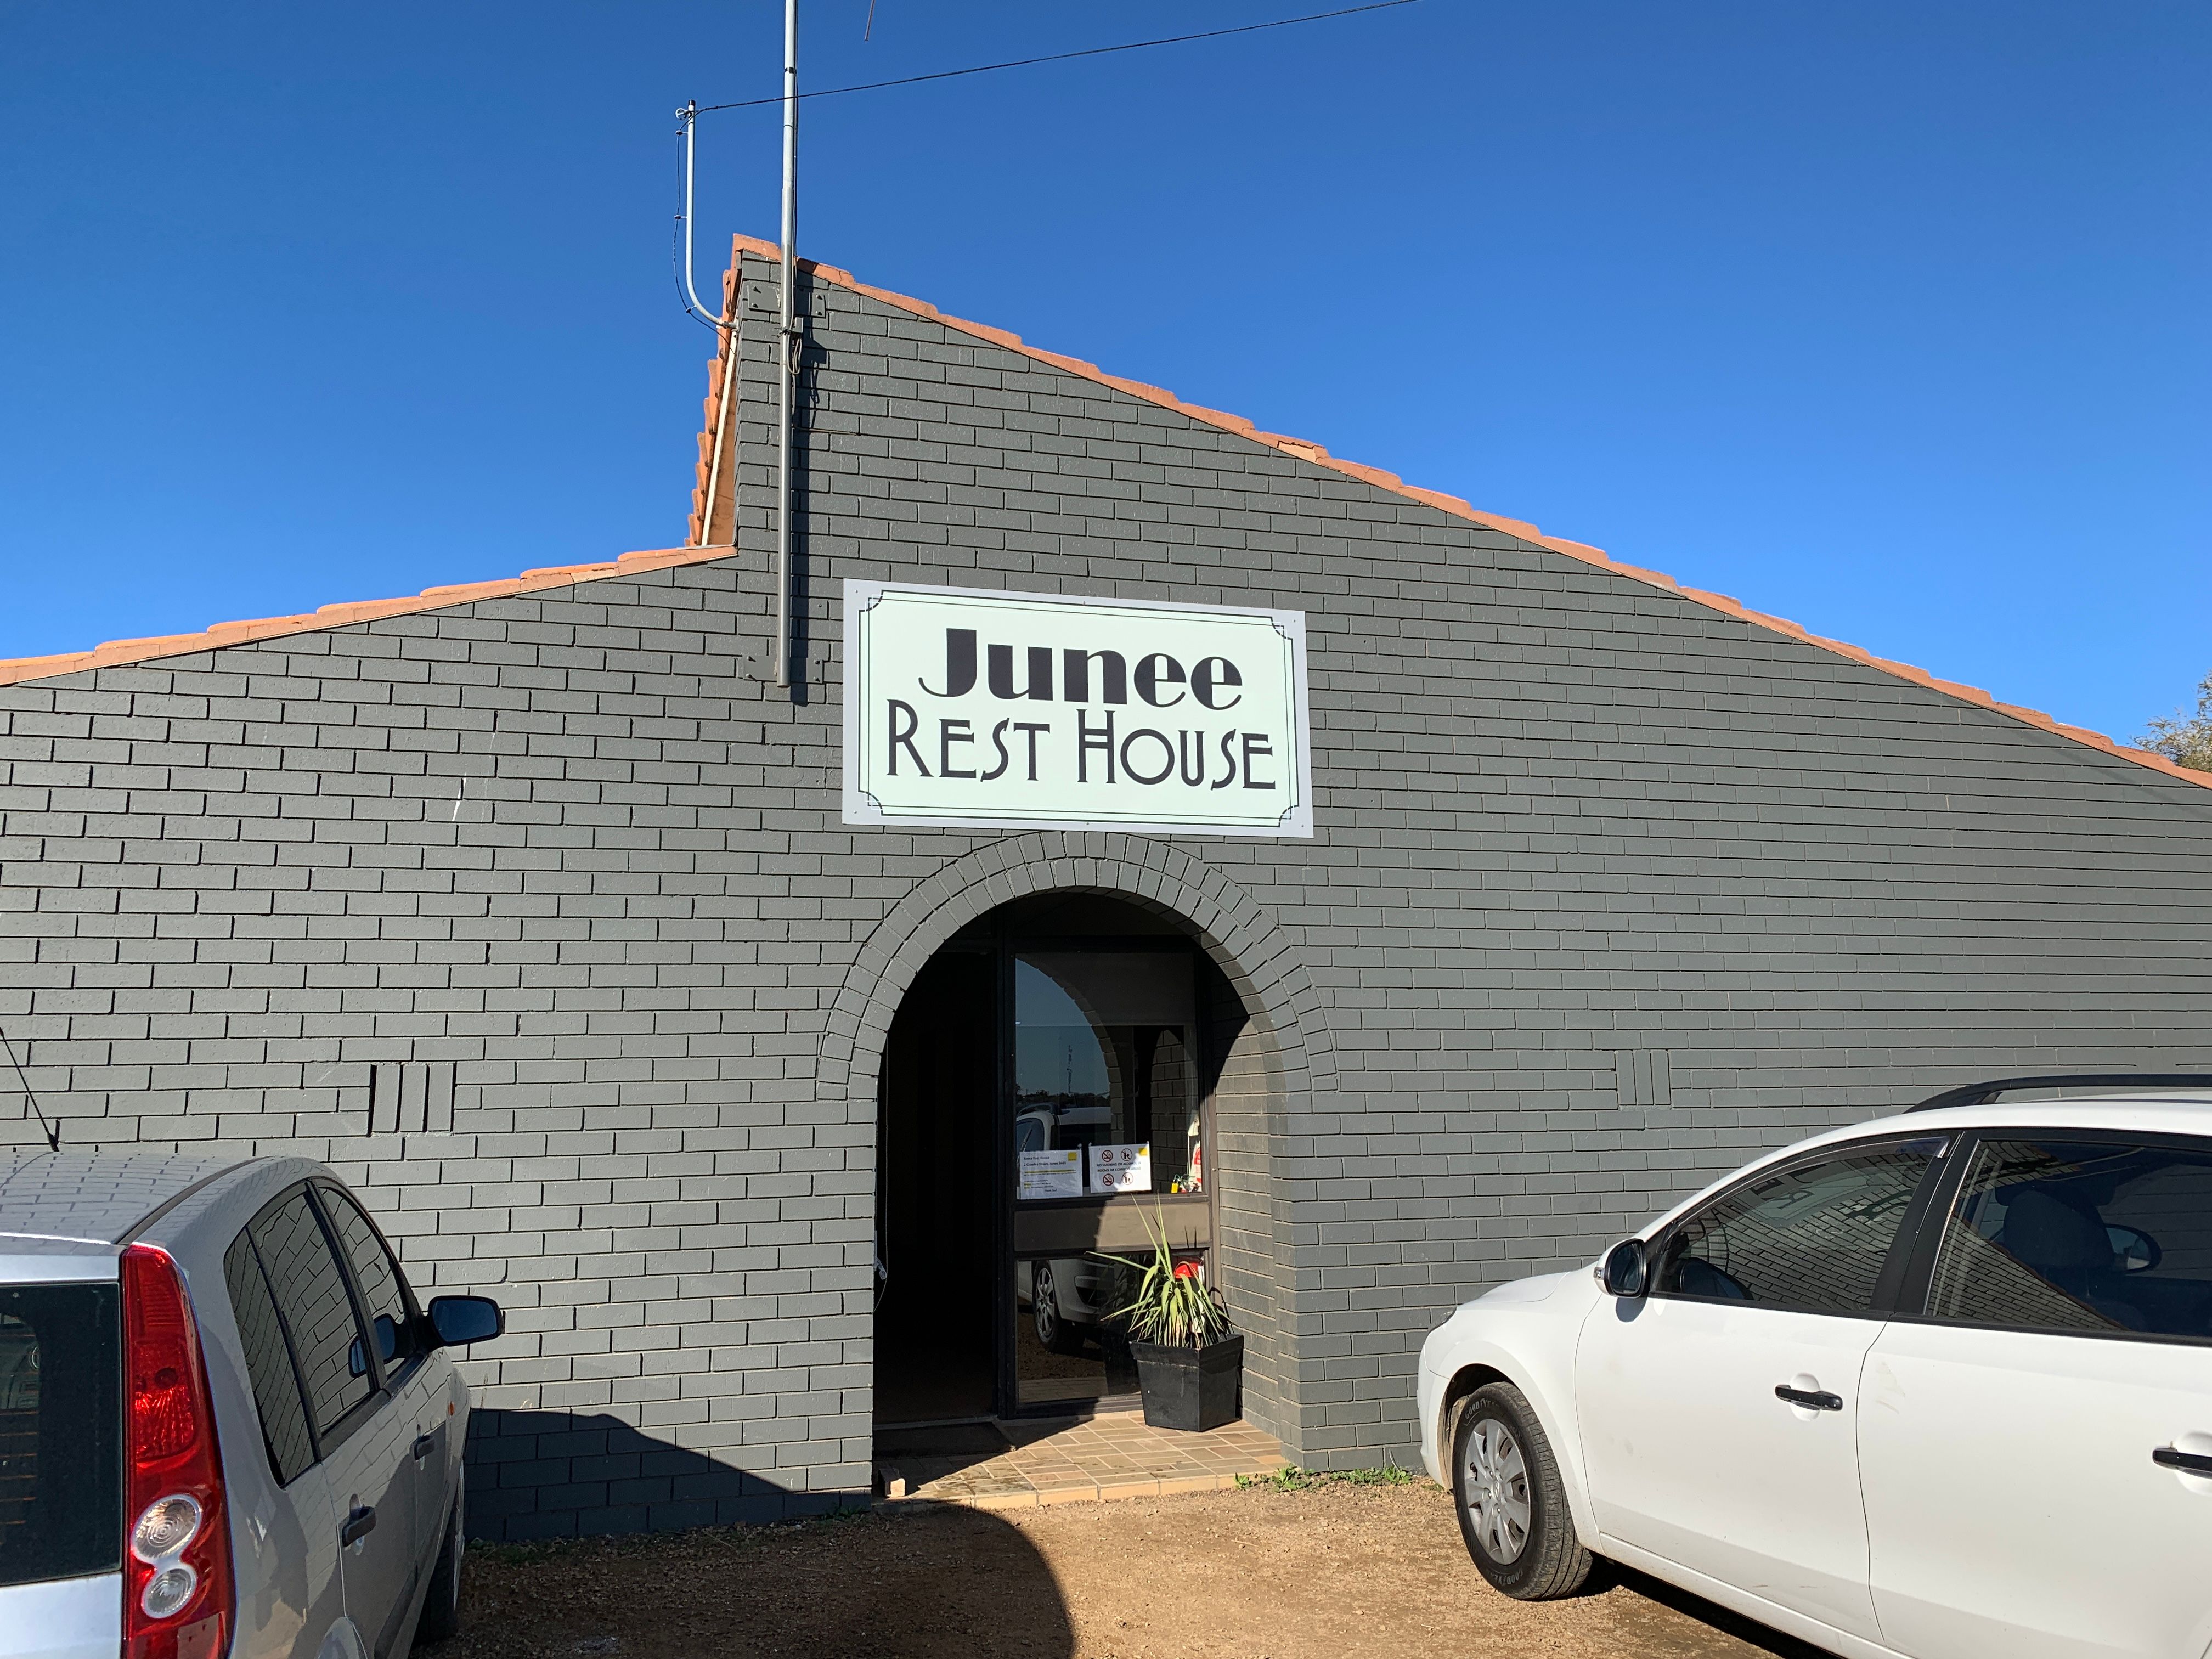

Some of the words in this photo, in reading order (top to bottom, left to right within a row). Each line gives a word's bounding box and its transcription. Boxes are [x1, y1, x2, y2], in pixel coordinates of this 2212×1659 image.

[918, 628, 1243, 710] Junee
[886, 699, 1050, 782] REST
[1076, 709, 1276, 791] HOUSE
